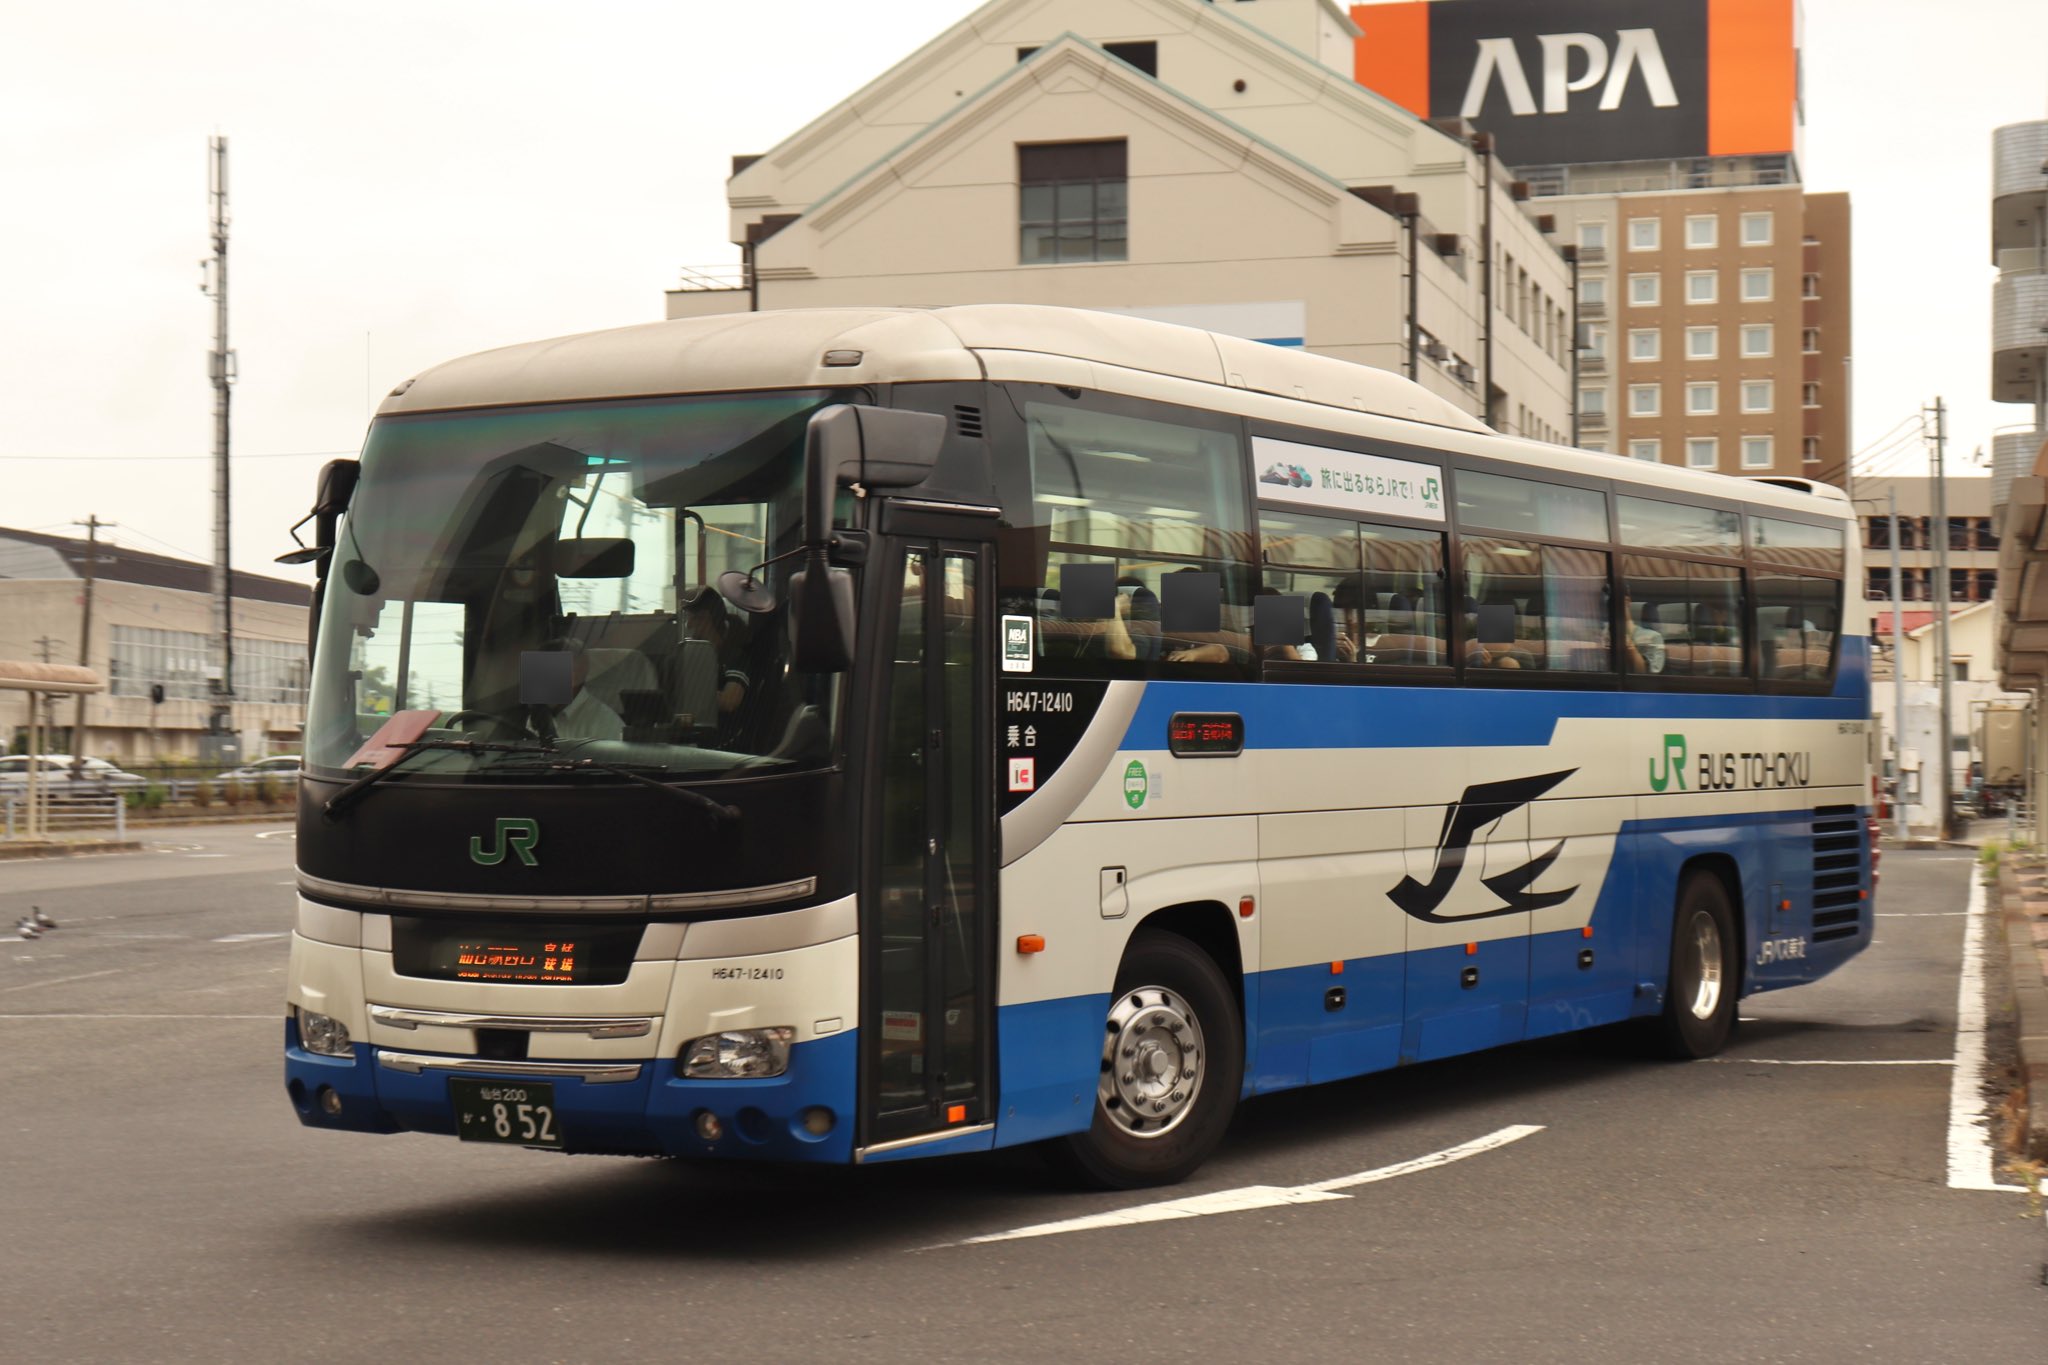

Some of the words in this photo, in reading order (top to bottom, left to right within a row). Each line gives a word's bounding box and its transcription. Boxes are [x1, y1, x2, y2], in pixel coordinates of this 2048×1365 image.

[1459, 28, 1680, 118] APA
[1420, 477, 1439, 501] JR
[1006, 691, 1074, 712] H647-12410
[1650, 734, 1687, 792] JR
[1699, 752, 1736, 790] BUS
[1740, 751, 1810, 788] TOHOKU
[470, 817, 539, 866] JR
[712, 968, 785, 981] H647-12410
